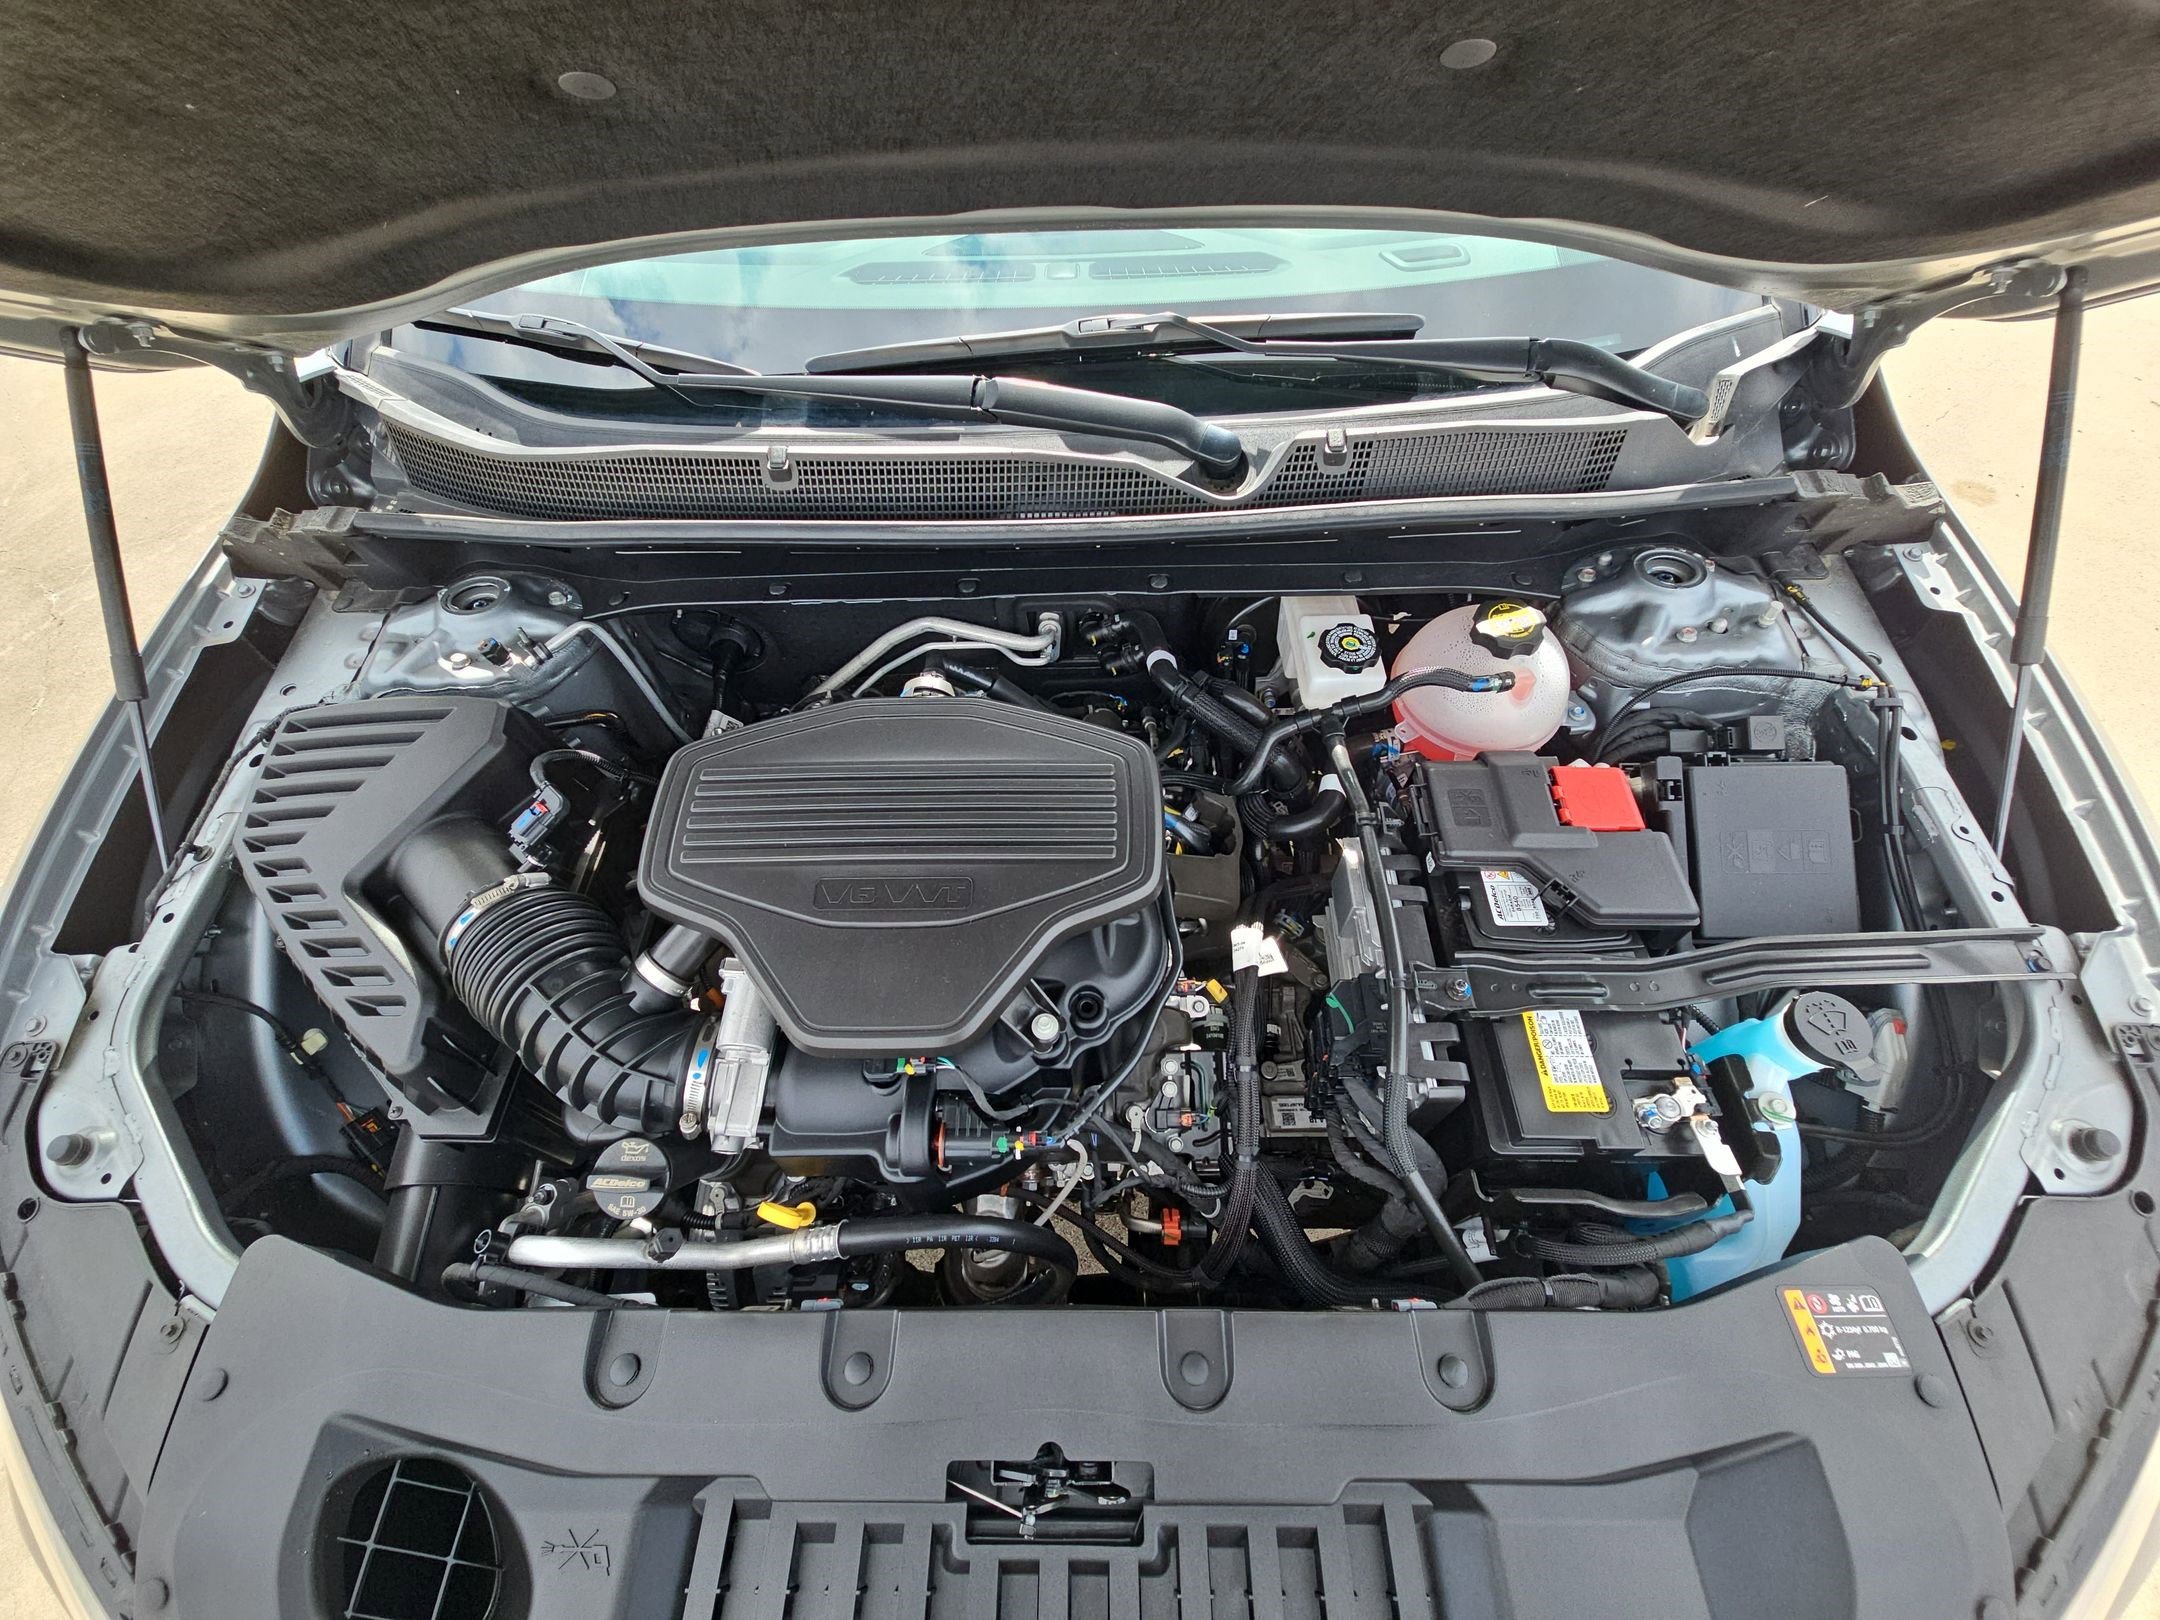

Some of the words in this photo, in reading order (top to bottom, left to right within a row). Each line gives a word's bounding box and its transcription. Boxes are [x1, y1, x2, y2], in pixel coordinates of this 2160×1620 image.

[820, 883, 877, 904] V6
[1490, 885, 1504, 920] ACDelco
[590, 1178, 645, 1188] ACDelco
[607, 1203, 620, 1215] SAE
